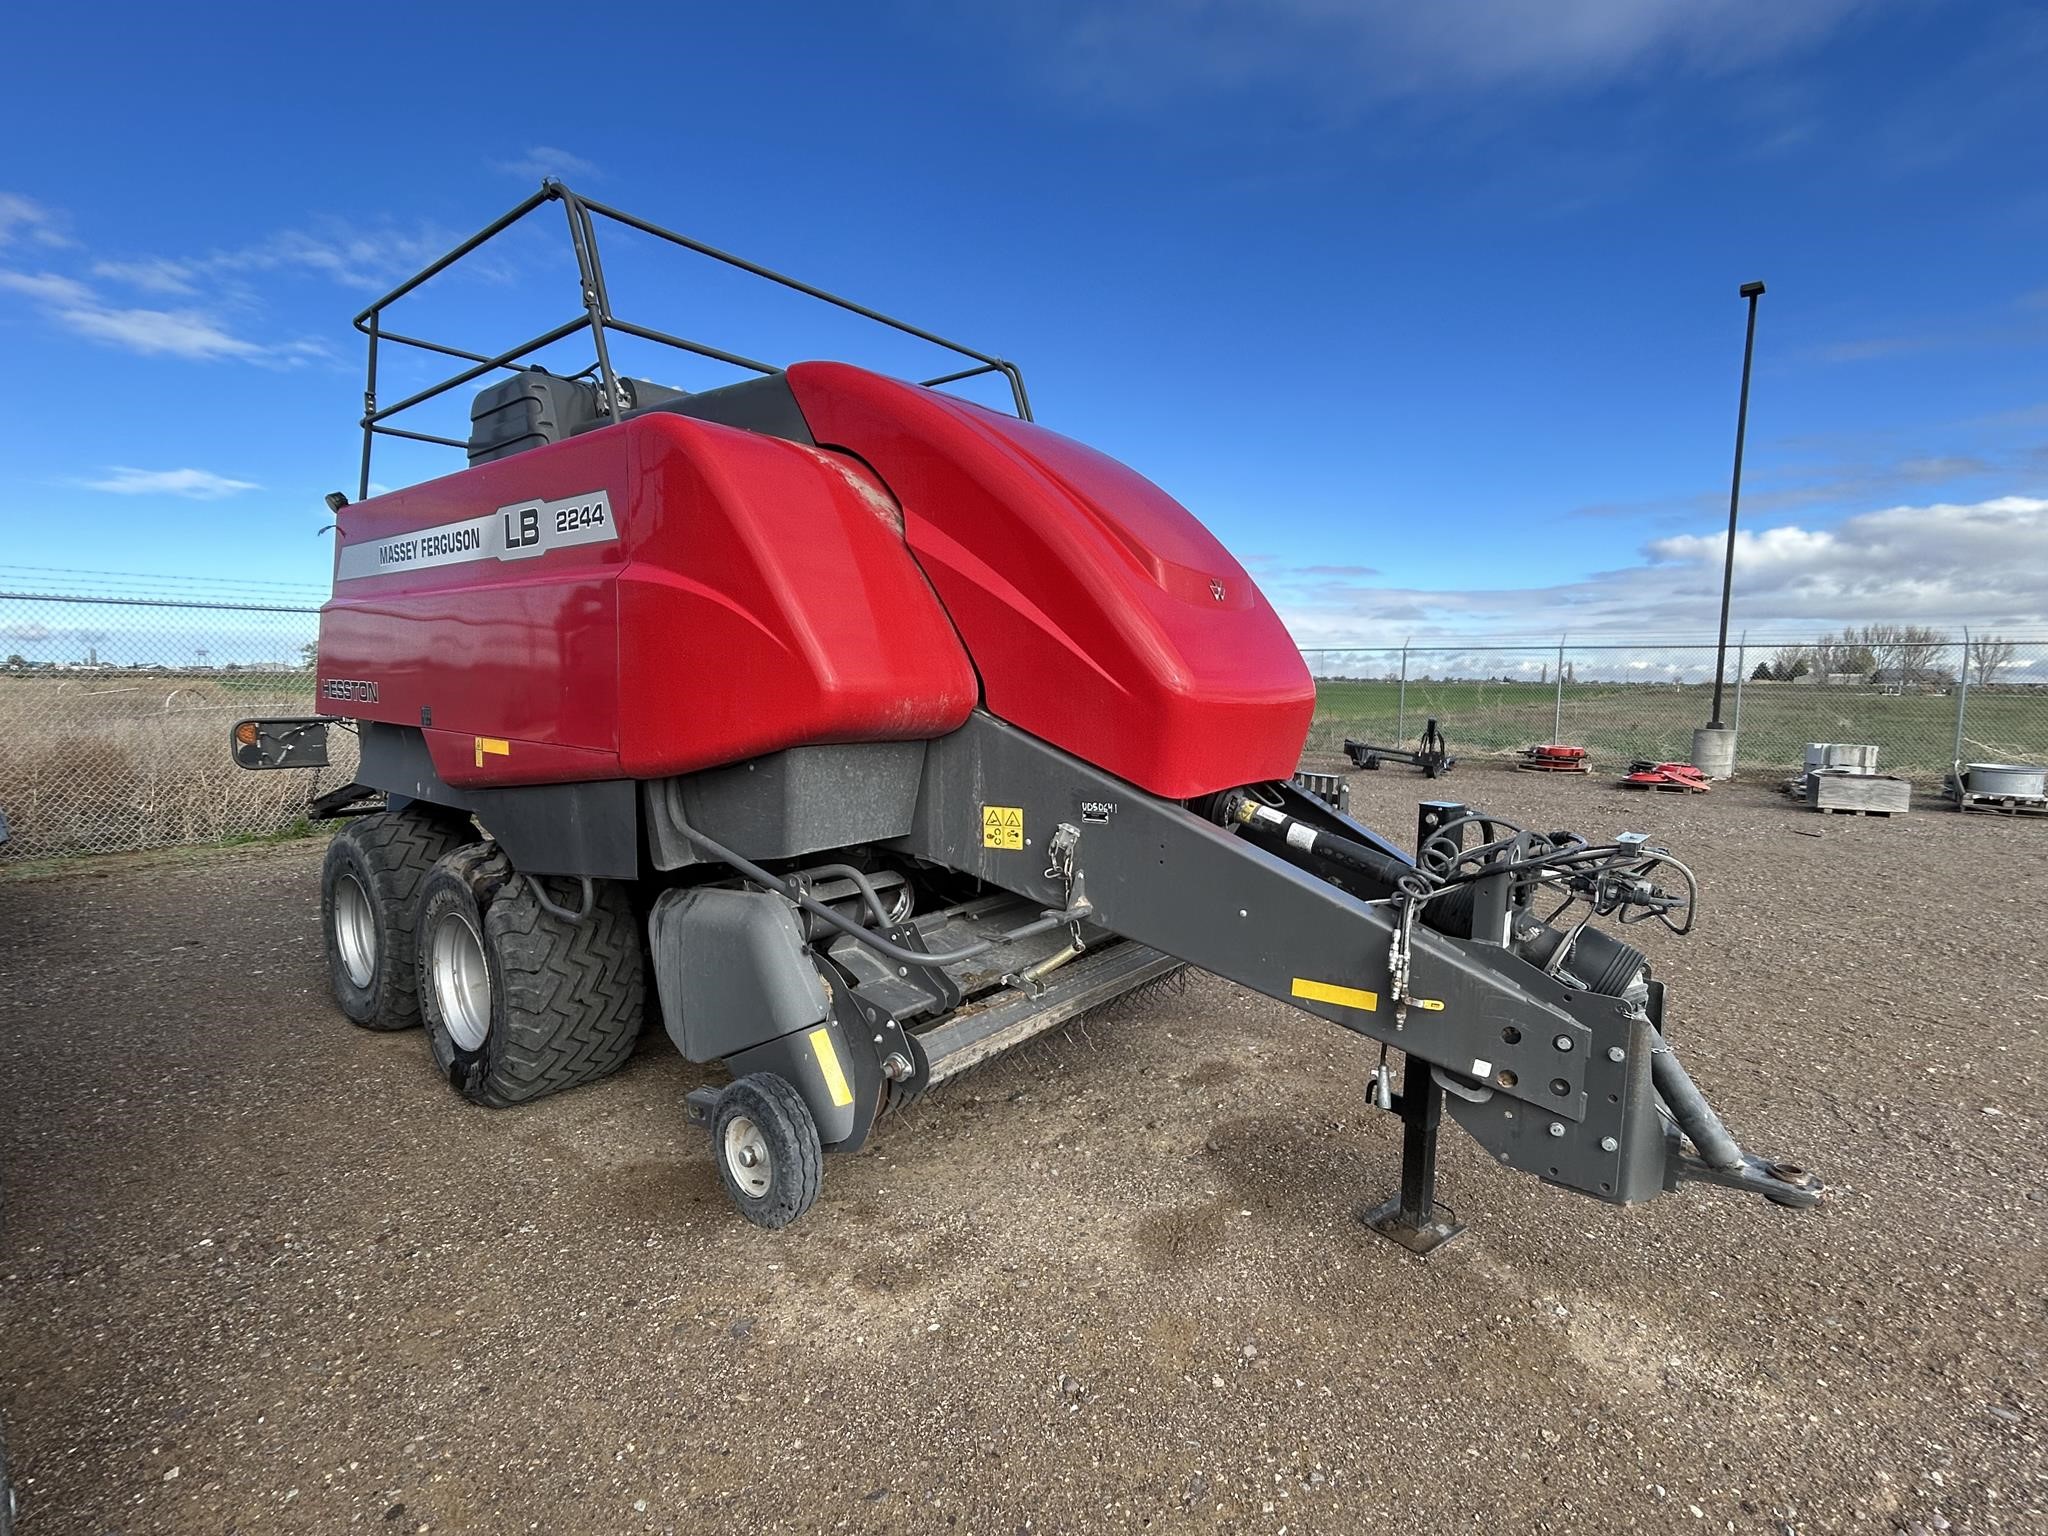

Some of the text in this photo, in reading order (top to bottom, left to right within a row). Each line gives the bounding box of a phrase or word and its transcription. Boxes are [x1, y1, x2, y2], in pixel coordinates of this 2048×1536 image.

[379, 502, 604, 565] MASSEY FERGUSON LB 2244
[321, 679, 379, 703] HESSTON
